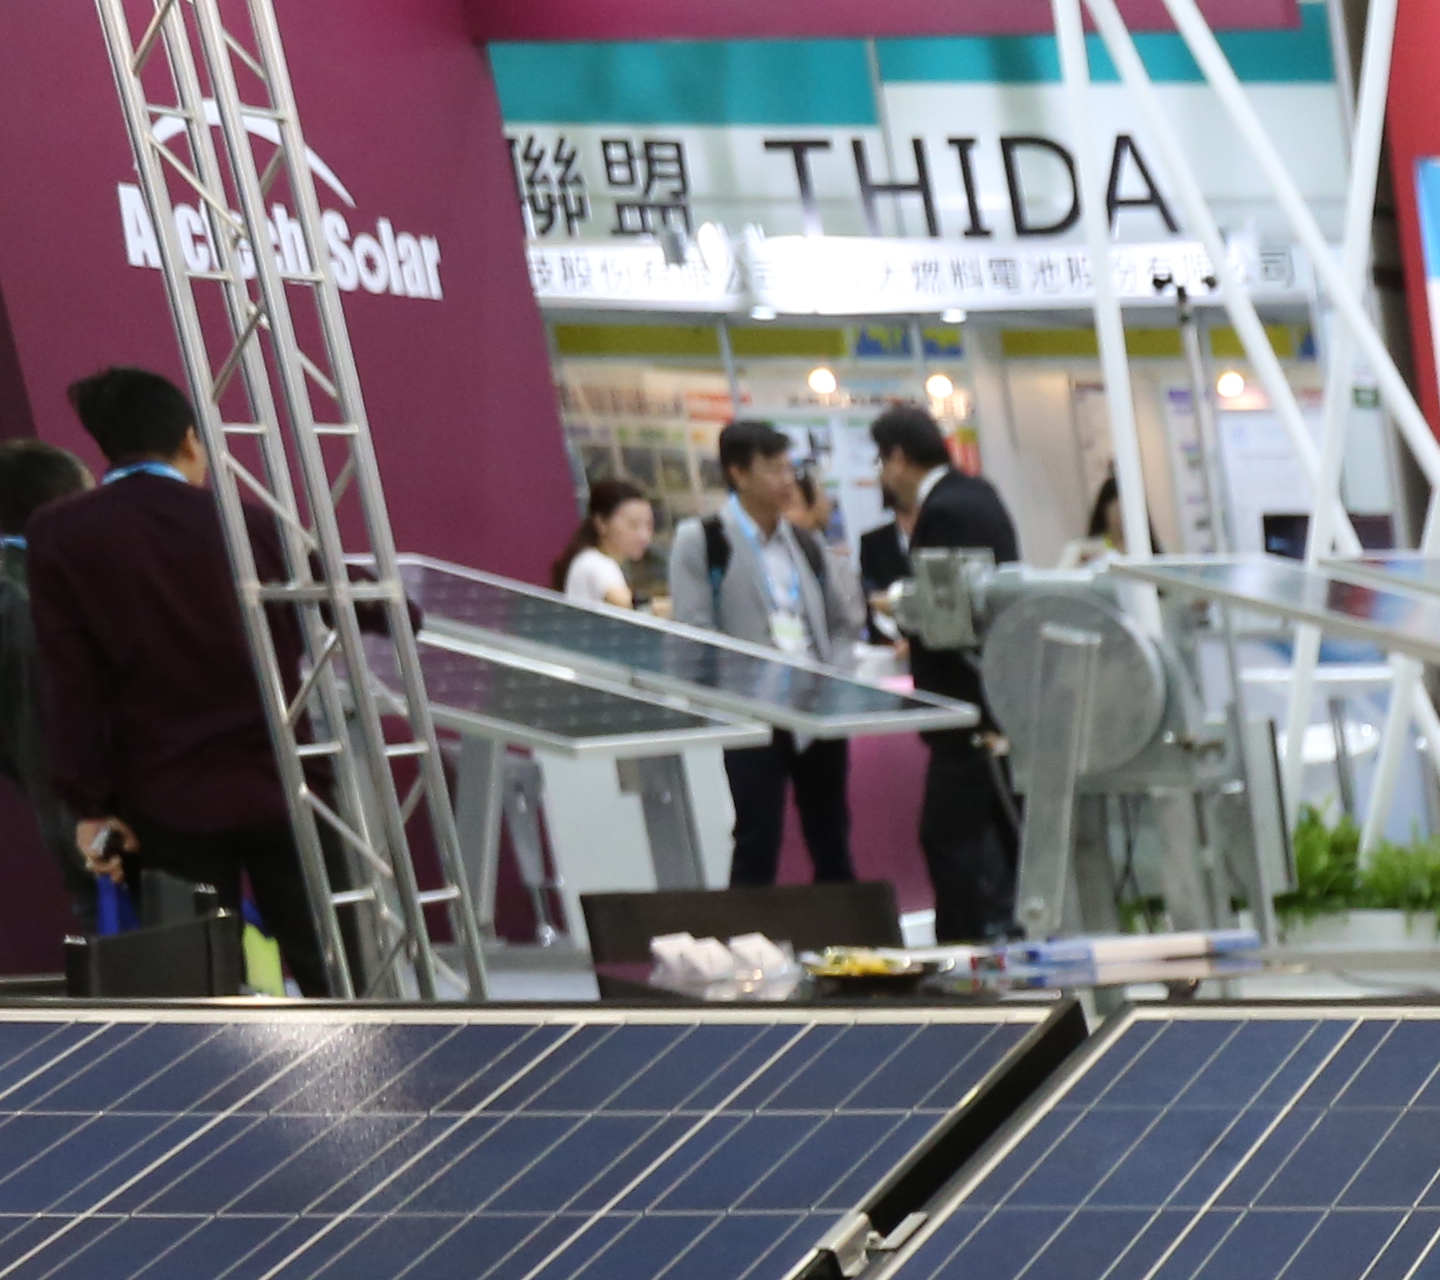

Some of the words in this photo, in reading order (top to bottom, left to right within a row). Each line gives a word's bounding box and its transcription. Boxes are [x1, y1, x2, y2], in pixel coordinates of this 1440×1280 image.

[117, 182, 317, 286] Actech
[320, 208, 443, 301] Solar
[763, 133, 1181, 238] THIDA
